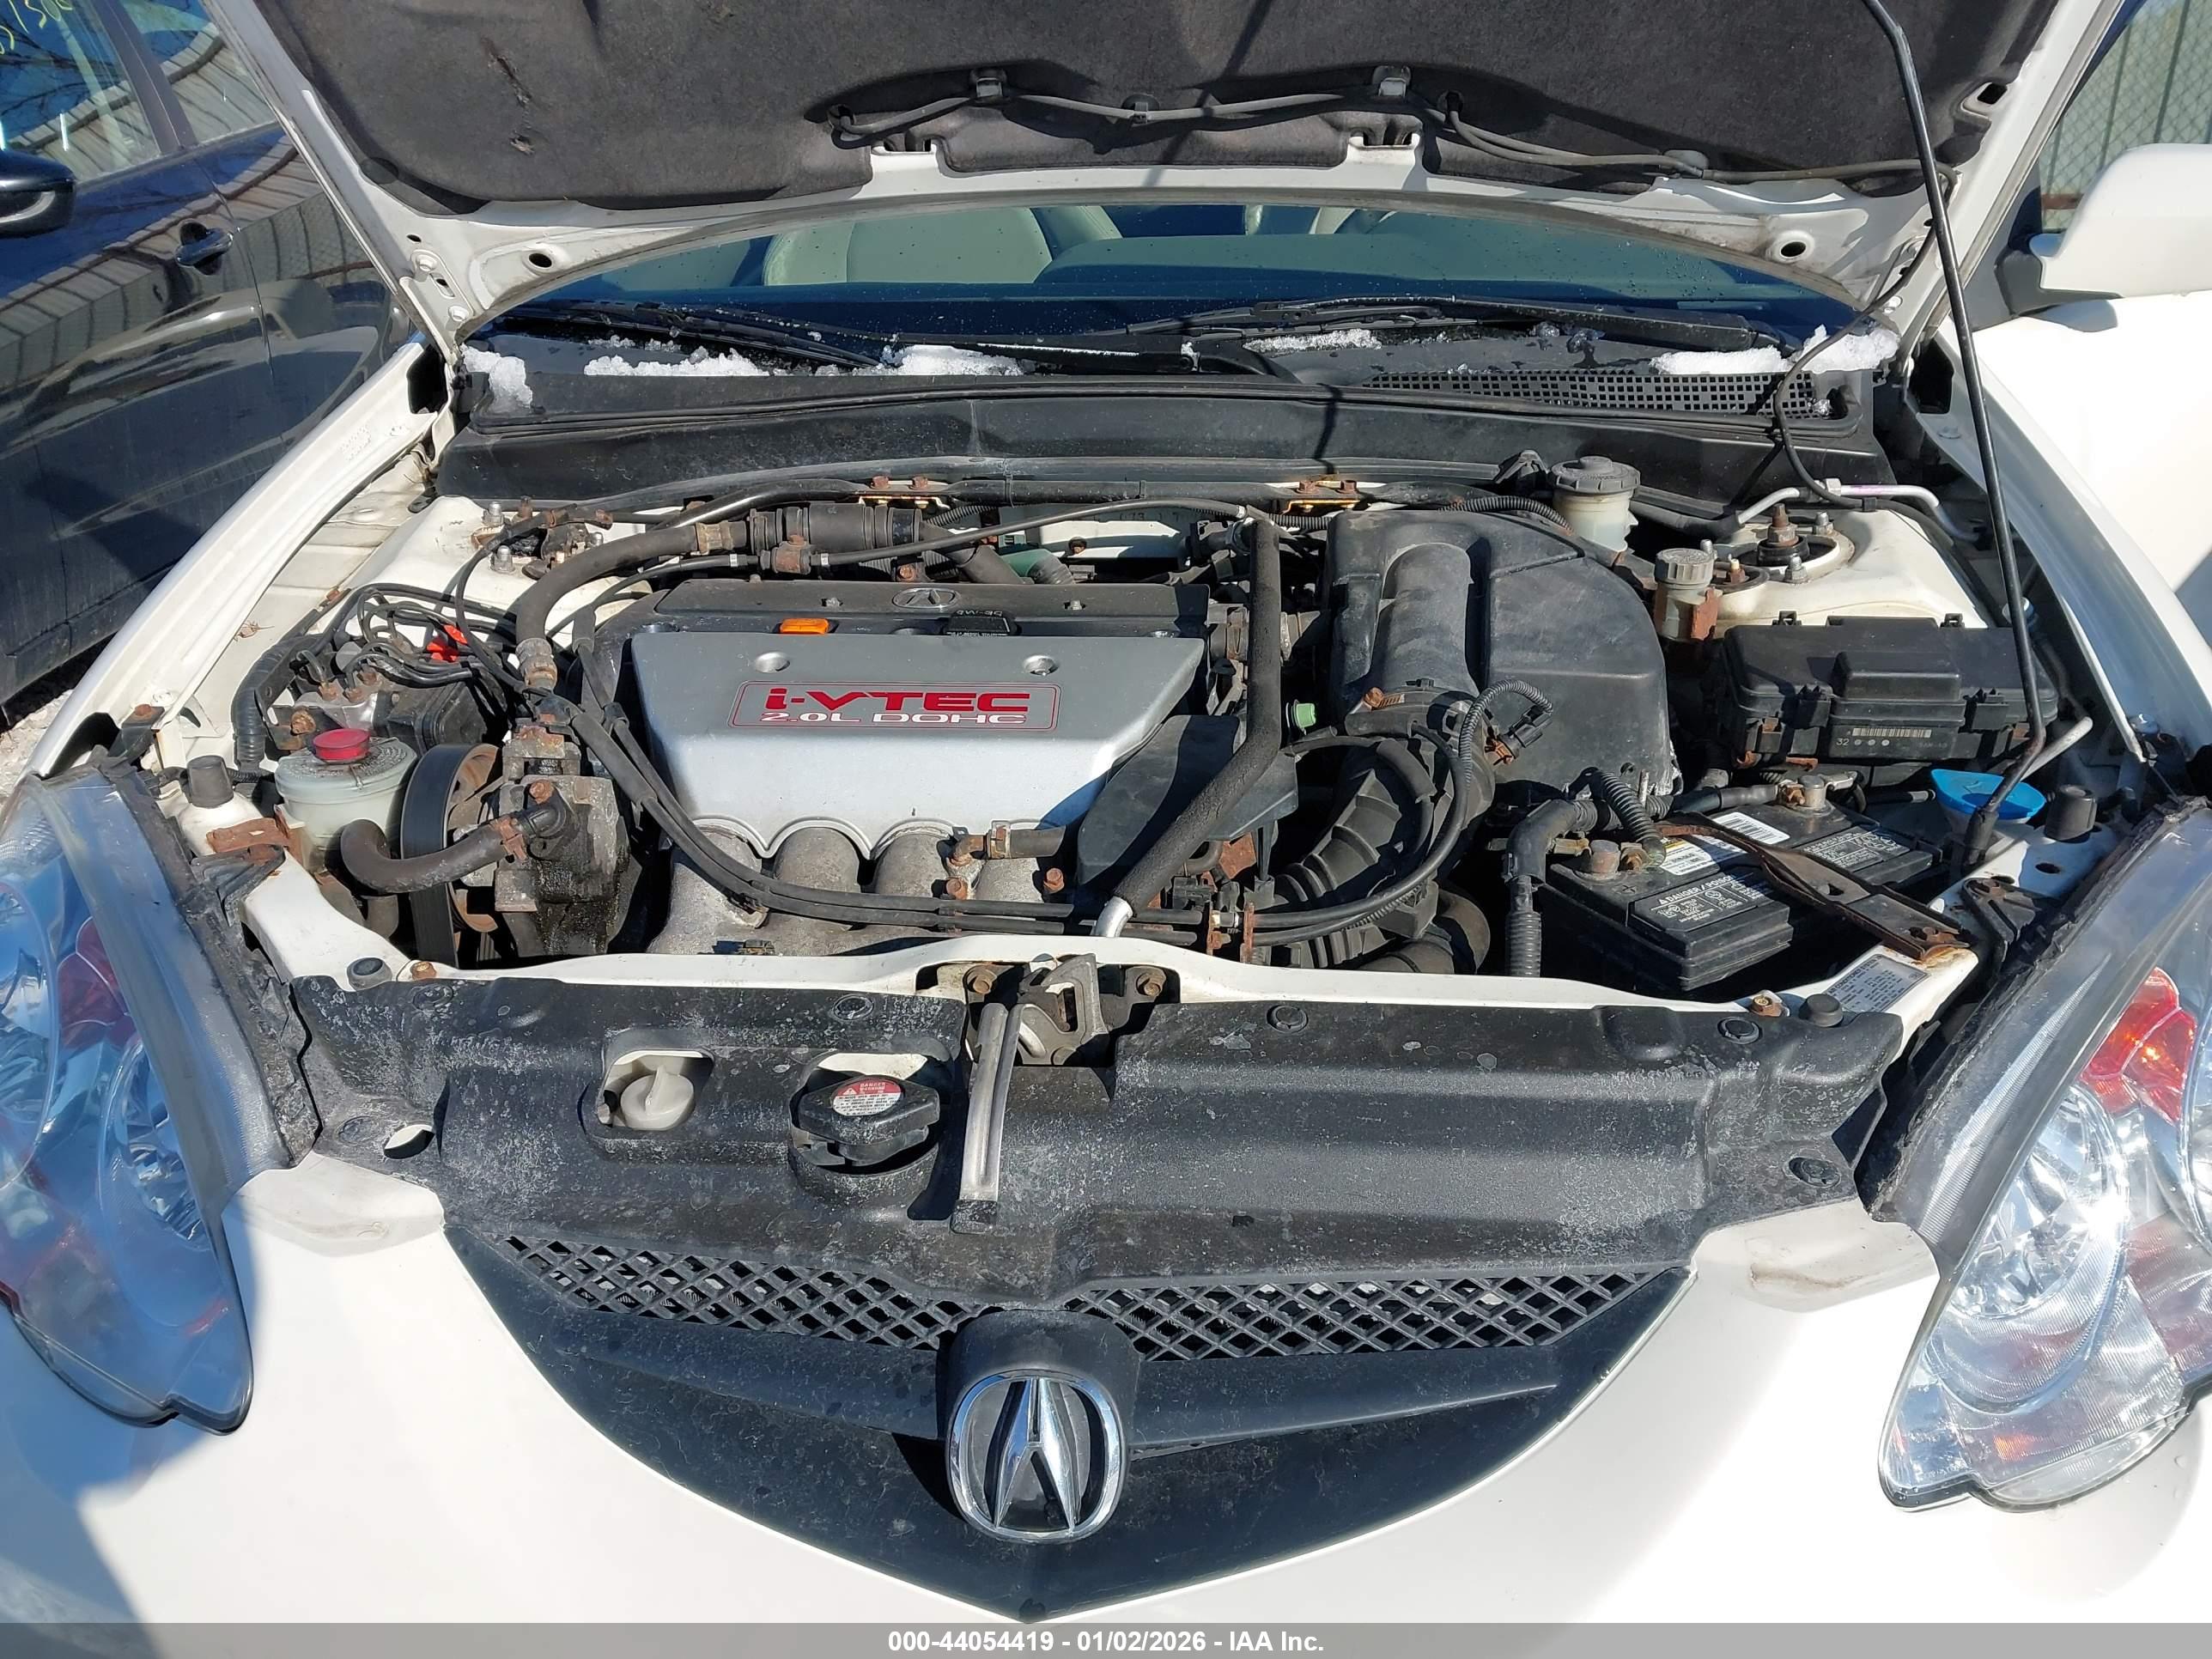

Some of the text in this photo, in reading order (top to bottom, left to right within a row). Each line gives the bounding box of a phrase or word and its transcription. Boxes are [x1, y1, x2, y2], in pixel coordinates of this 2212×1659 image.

[765, 688, 1030, 712] i-VTEC
[760, 712, 1026, 725] 2.0L DOHC
[1836, 738, 1850, 746] 32
[1665, 887, 1702, 902] DANGER
